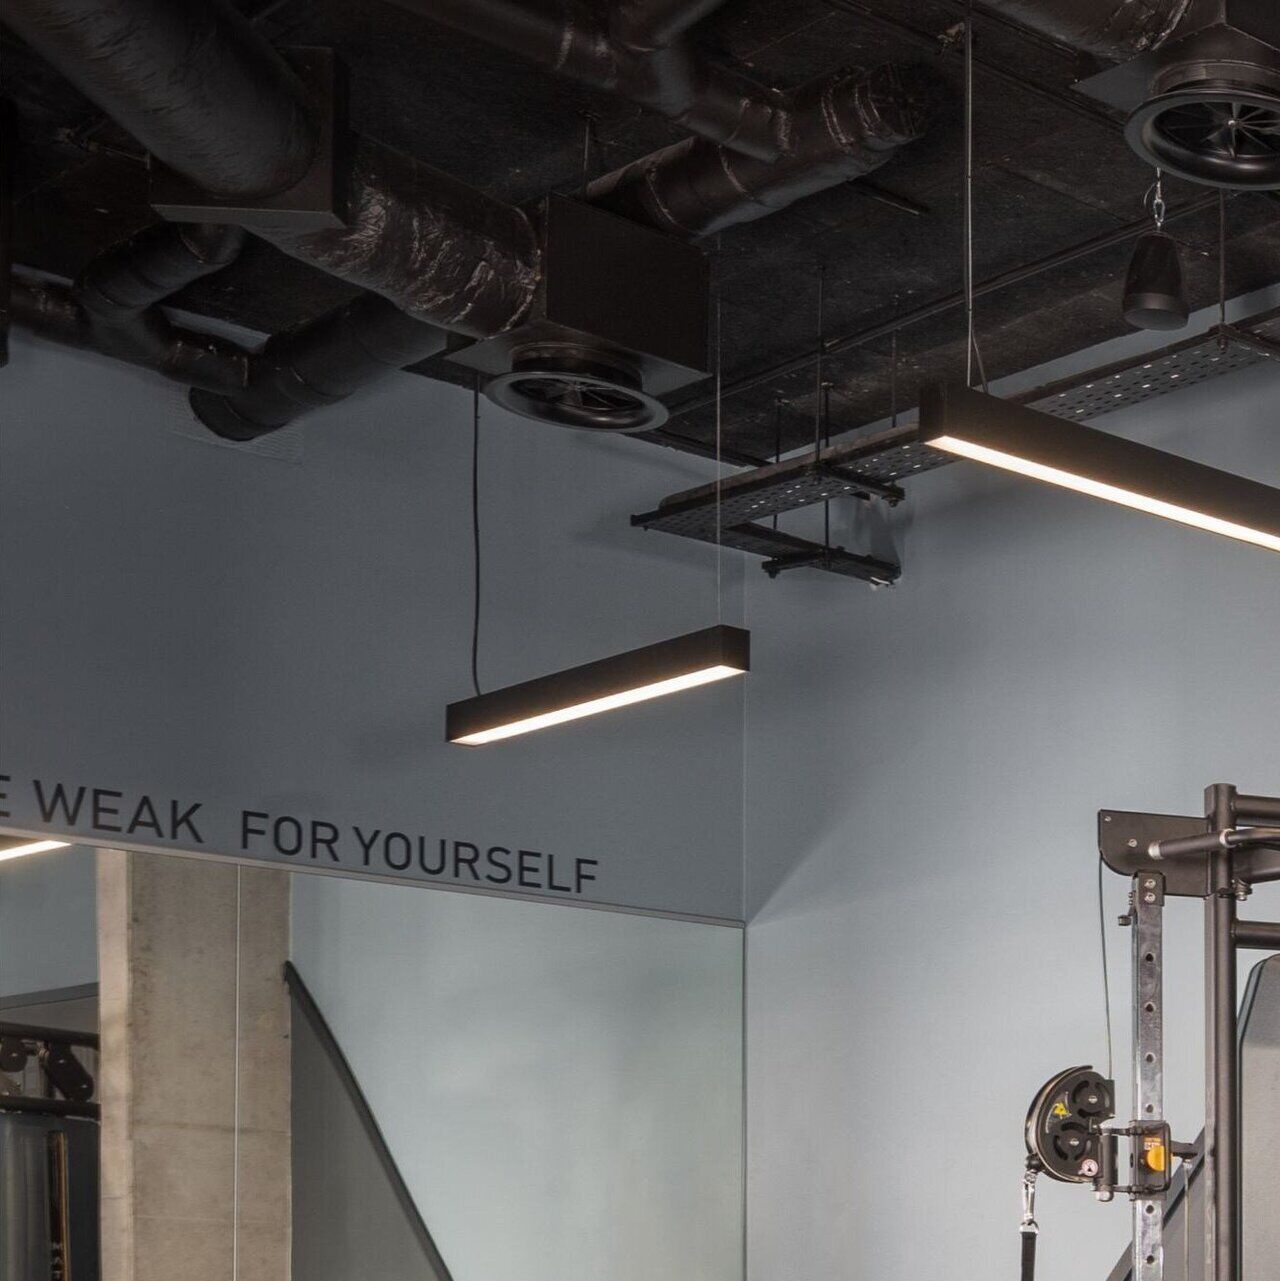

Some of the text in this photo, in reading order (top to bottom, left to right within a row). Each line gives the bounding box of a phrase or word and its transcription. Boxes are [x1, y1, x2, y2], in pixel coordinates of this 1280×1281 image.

[33, 779, 205, 844] WEAK
[241, 810, 340, 863] FOR
[352, 826, 600, 895] YOURSELF
